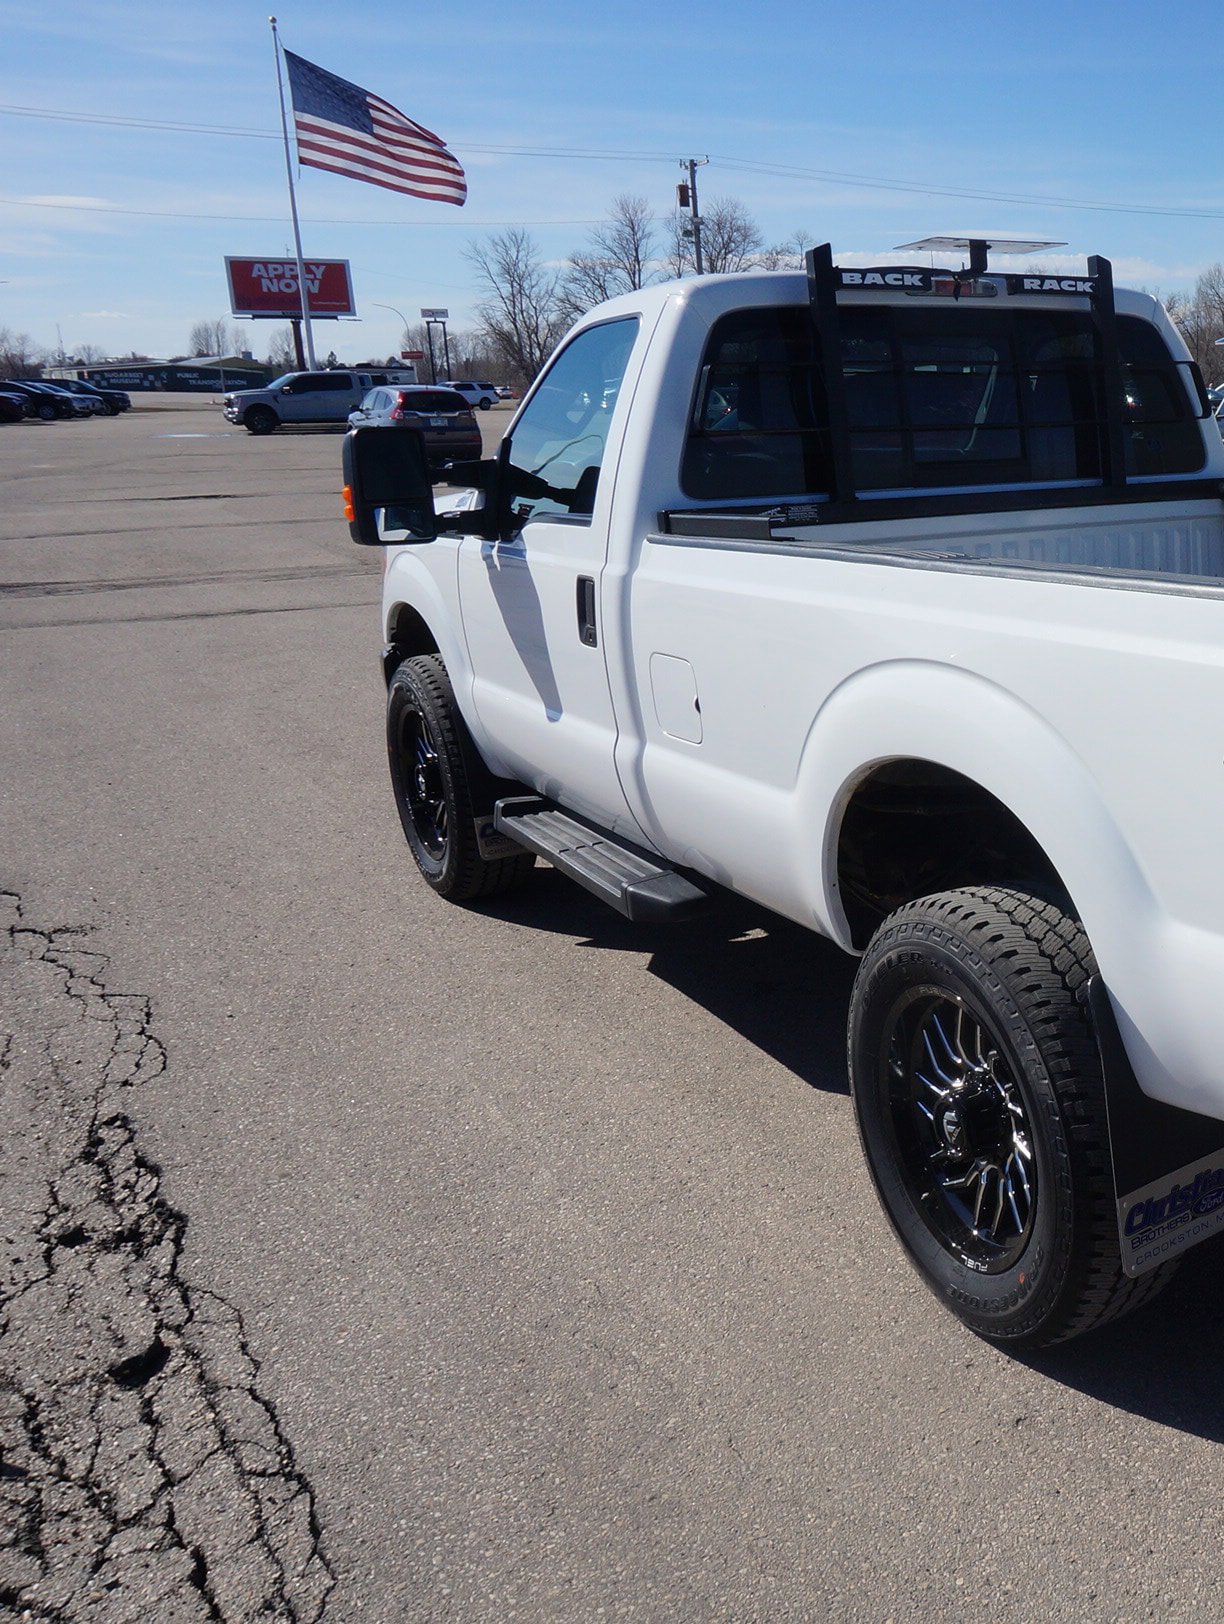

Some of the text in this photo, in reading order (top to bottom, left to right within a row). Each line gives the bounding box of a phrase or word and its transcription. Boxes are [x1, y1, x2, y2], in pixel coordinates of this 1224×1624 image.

[251, 263, 326, 279] APPLY
[262, 279, 320, 293] NOW
[842, 272, 1093, 293] BACK RACK
[1131, 1190, 1224, 1250] BROTHERS Ford
[1135, 1220, 1210, 1266] CROOKSTON
[960, 1254, 988, 1272] FUEL
